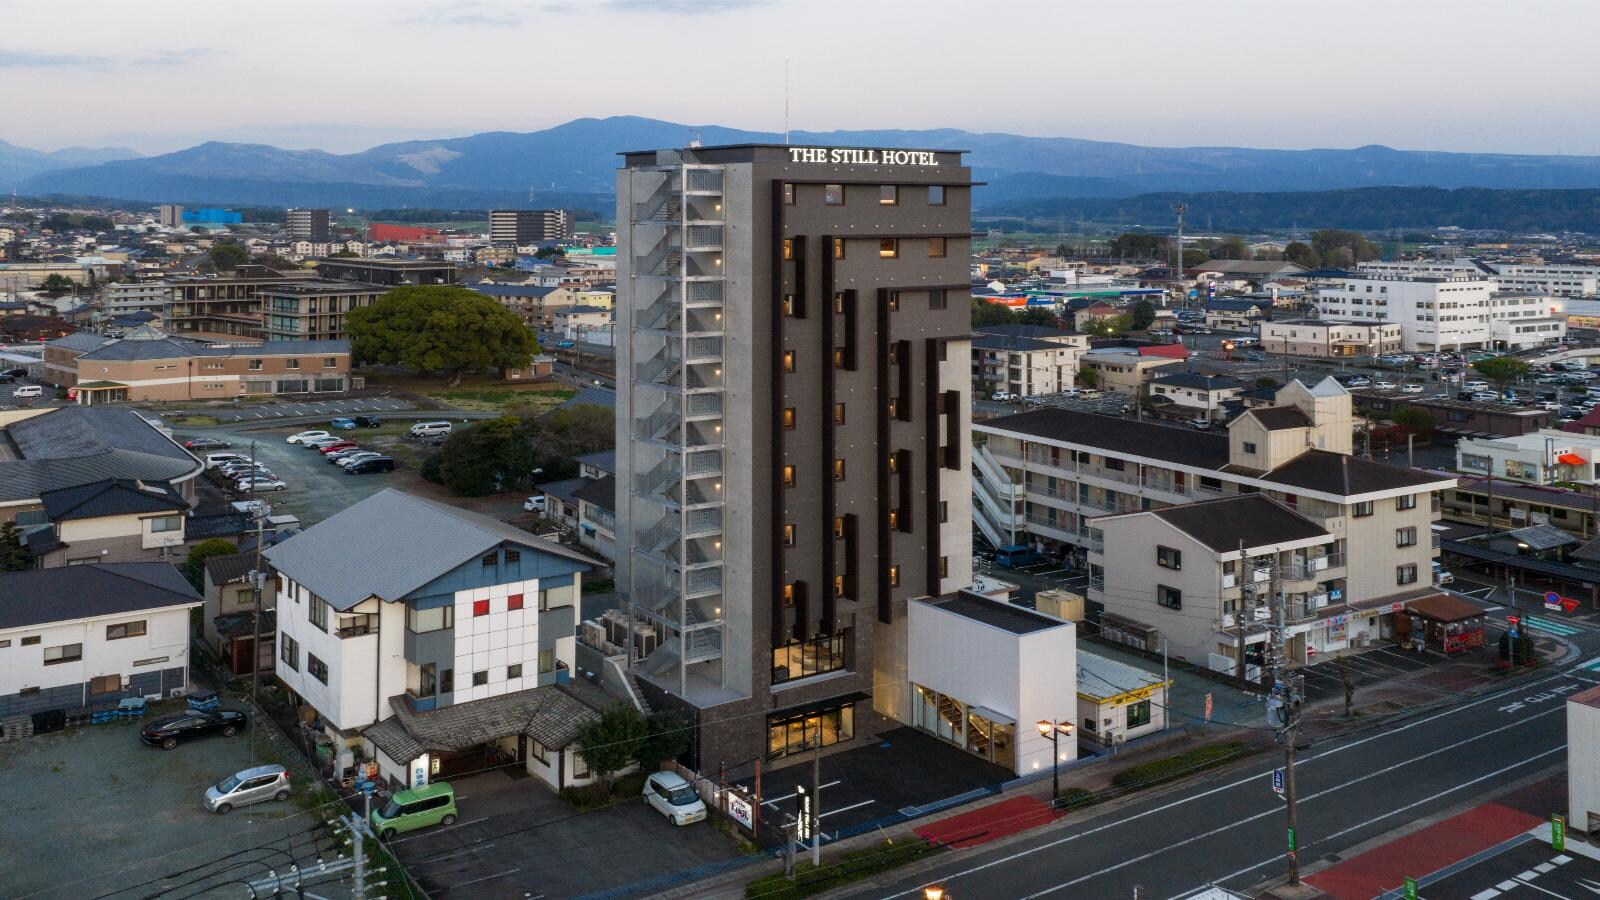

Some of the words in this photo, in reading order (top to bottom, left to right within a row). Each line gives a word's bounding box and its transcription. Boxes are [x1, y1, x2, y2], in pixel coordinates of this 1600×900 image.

[790, 148, 827, 163] THE
[831, 149, 878, 164] STILL
[882, 151, 938, 166] HOTEL
[1497, 684, 1579, 713] 止まれ
